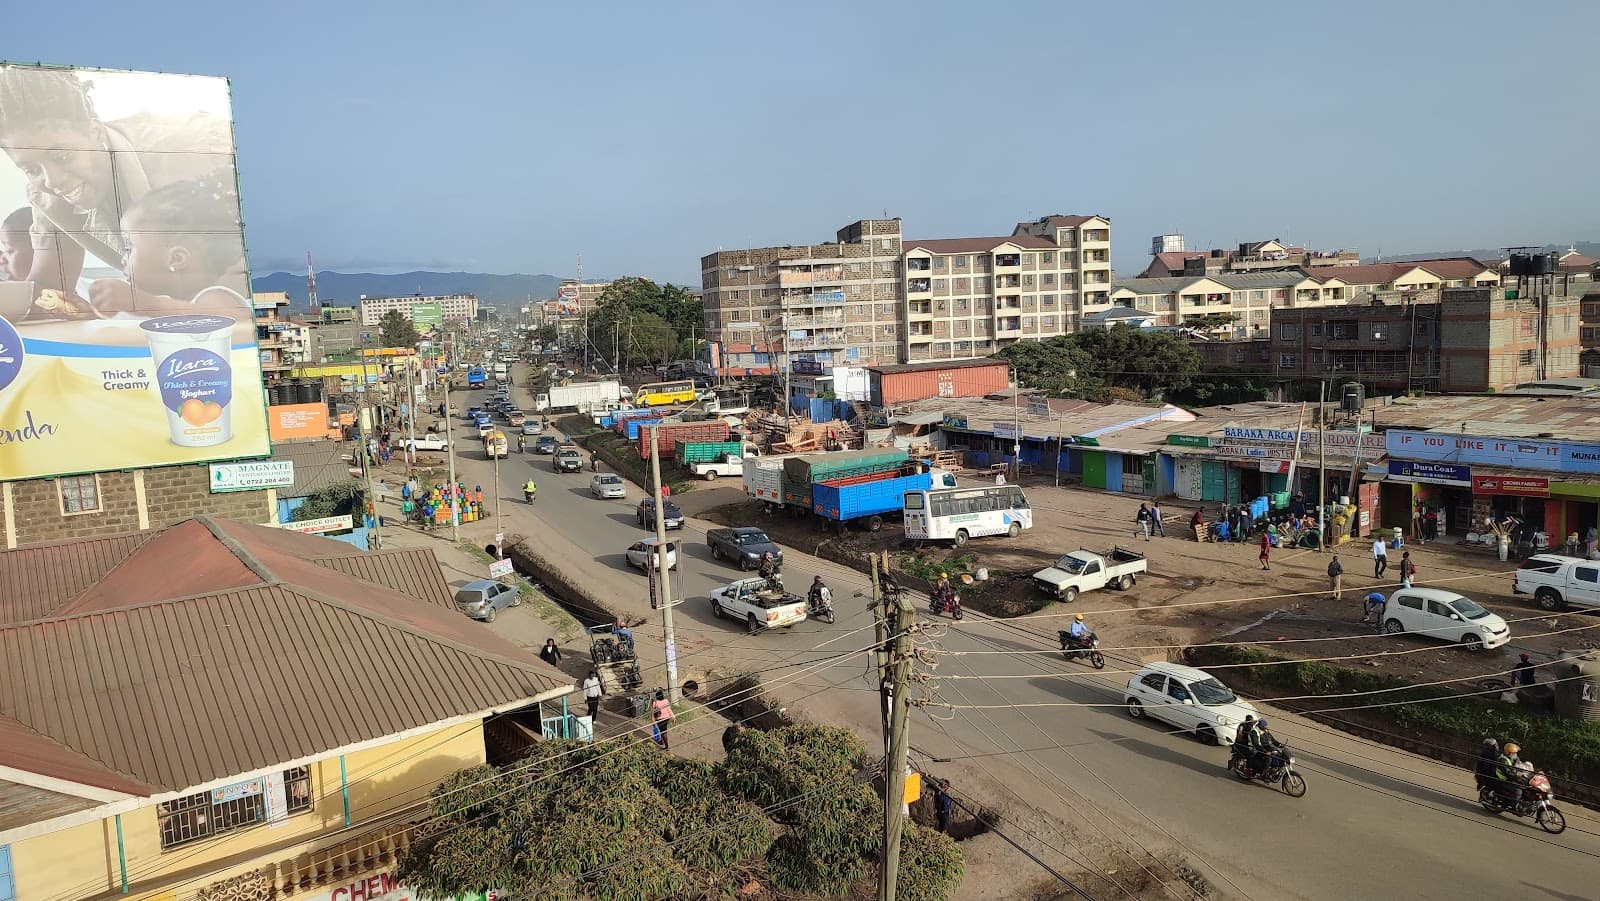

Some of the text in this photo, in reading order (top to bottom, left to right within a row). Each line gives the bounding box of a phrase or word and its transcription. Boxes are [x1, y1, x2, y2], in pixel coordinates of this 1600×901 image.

[168, 357, 217, 377] Ilara
[102, 369, 146, 380] Thick &
[104, 381, 150, 391] Creamy
[164, 379, 229, 389] Thick & Creamy
[179, 388, 217, 399] Yoghurt
[1225, 427, 1308, 441] BARAKA ARCAE
[1401, 436, 1413, 444] IF
[1423, 438, 1445, 447] YOU
[1455, 440, 1484, 450] LIKE
[1546, 447, 1559, 456] IT
[239, 463, 290, 473] MAGNATE
[296, 520, 323, 528] CHOICE
[325, 516, 351, 525] OUTLET
[331, 872, 406, 901] CHEM
